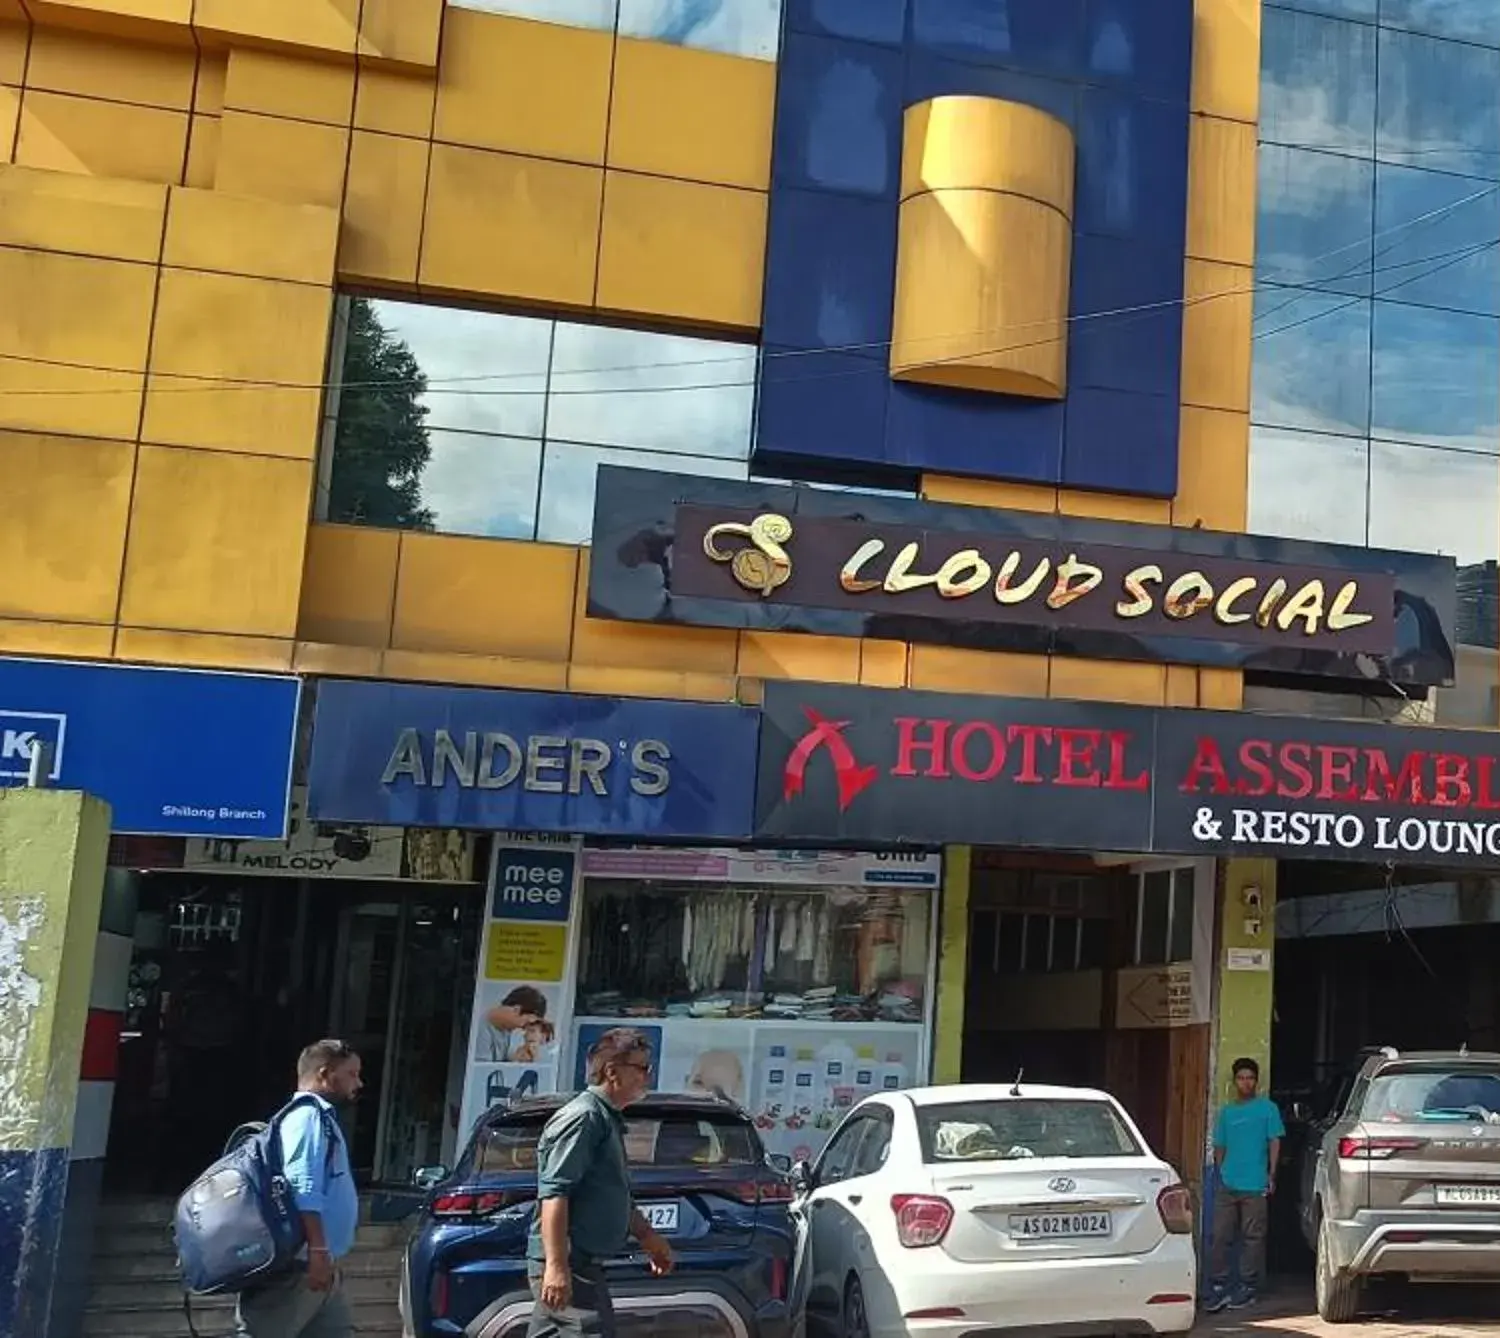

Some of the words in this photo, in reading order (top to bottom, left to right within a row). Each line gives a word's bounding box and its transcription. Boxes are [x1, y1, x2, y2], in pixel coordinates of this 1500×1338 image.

[839, 538, 1103, 609] CLOUD
[1114, 563, 1375, 636] SOCIAL
[888, 717, 1149, 793] HOTEL
[162, 804, 215, 820] Shillong
[219, 806, 267, 821] Branch
[1191, 806, 1222, 841] &
[1232, 808, 1365, 849] RESTO
[243, 854, 339, 871] MELODY
[505, 865, 565, 884] mee
[503, 885, 562, 905] mee
[648, 1208, 675, 1225] 27
[1022, 1214, 1109, 1235] AS02M0024
